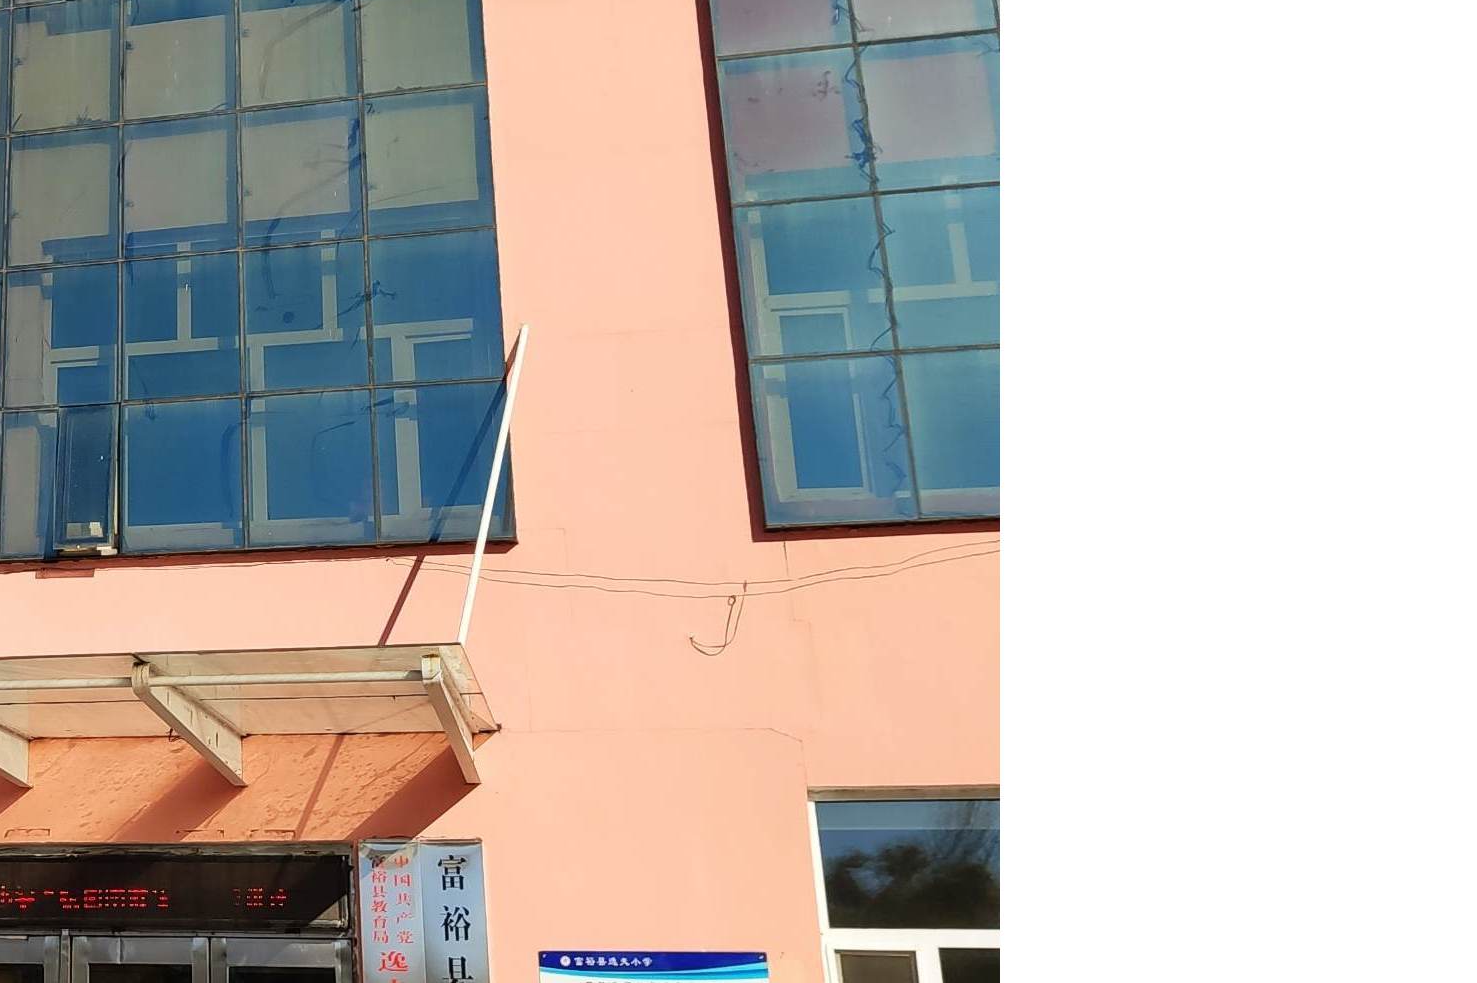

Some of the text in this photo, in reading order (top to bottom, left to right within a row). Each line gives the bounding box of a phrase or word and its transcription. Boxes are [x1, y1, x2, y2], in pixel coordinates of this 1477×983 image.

[394, 855, 414, 944] 中国共产党
[438, 854, 474, 983] 富裕县
[378, 951, 409, 983] 逸
[574, 956, 653, 967] 富裕县逸夫小学
